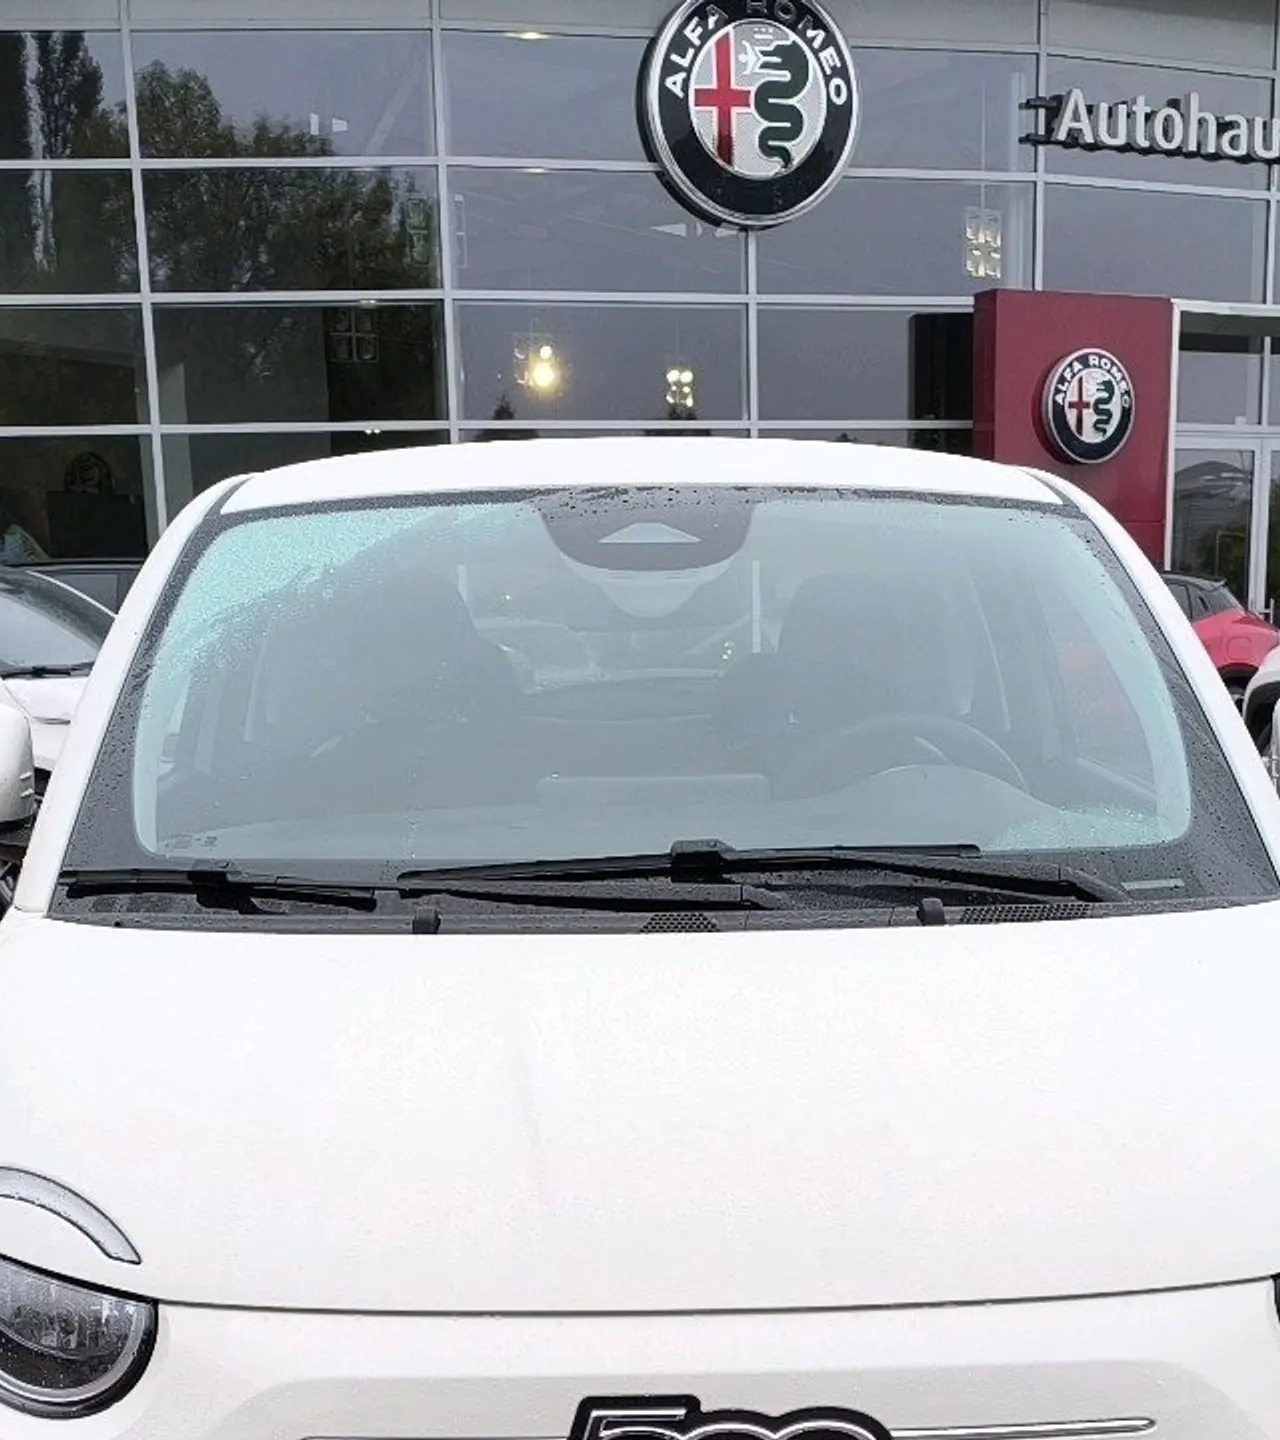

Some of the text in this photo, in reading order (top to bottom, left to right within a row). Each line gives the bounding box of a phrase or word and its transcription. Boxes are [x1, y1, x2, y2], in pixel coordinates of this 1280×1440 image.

[664, 4, 729, 99] ALFA
[1054, 354, 1132, 409] ALFA ROMEO
